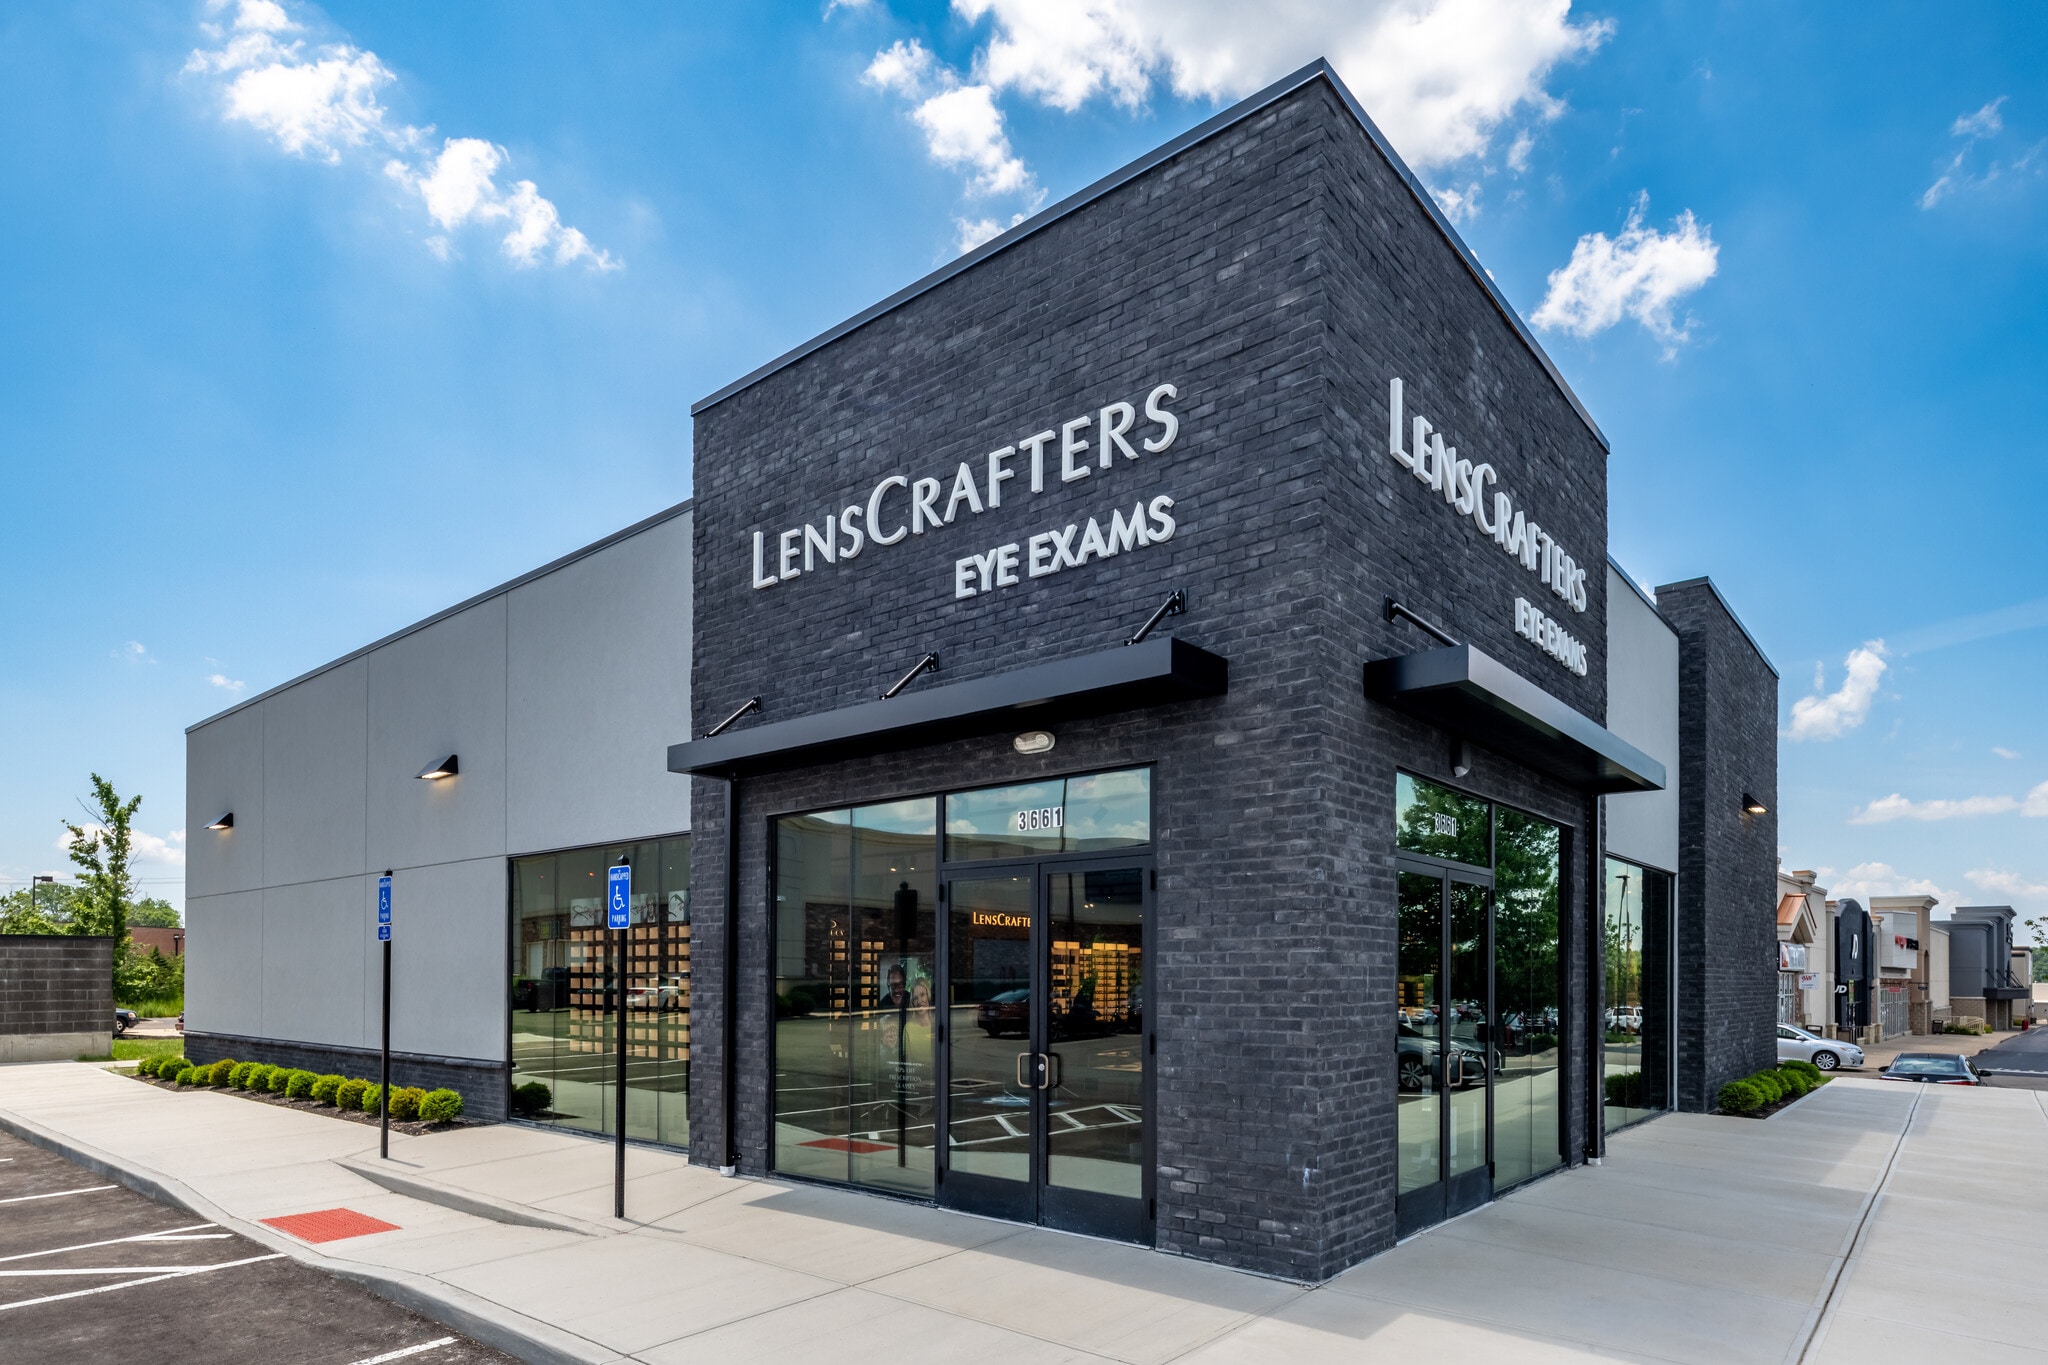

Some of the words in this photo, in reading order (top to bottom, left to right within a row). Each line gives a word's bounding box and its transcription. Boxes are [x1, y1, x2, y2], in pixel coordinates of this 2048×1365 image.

[955, 543, 1020, 599] EYE
[1029, 495, 1176, 578] EXAMS
[1018, 807, 1062, 830] 3661
[1435, 812, 1456, 836] 3661
[611, 914, 627, 923] PARKING
